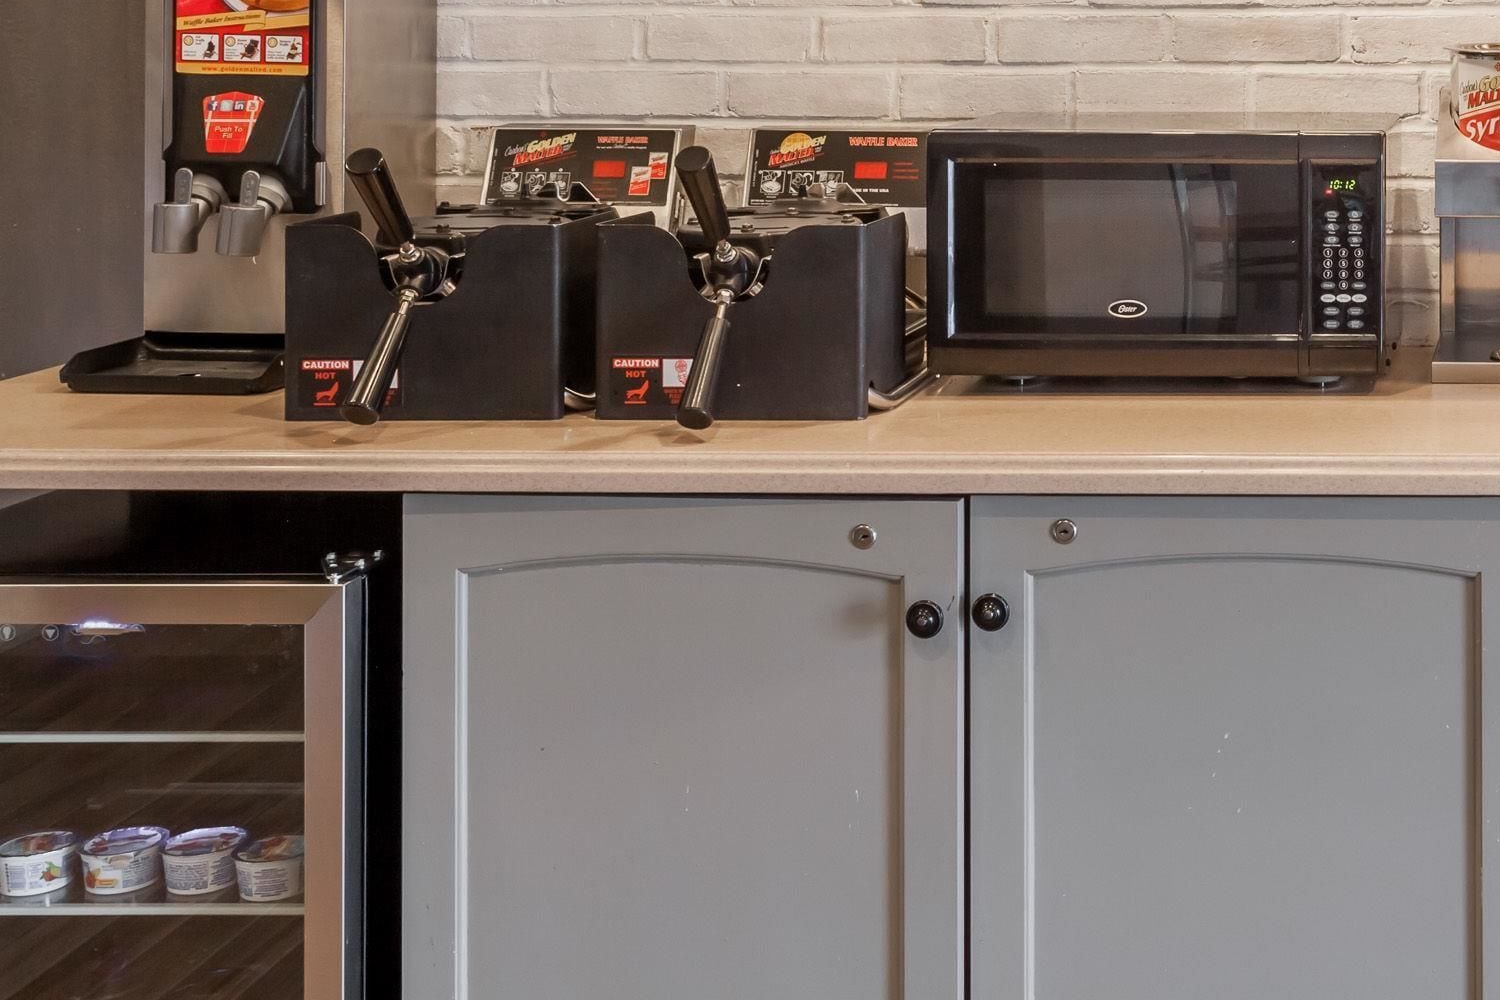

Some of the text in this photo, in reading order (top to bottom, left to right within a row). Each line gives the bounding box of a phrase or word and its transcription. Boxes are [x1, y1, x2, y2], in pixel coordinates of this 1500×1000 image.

[526, 132, 577, 153] GOLDEN
[848, 136, 919, 147] WAFFLE BAKER
[1330, 179, 1356, 190] 10:12
[1117, 304, 1138, 314] Oster
[303, 361, 349, 369] CAUTION
[614, 359, 659, 367] CAUTION
[314, 372, 336, 380] HOT
[625, 370, 647, 378] HOT
